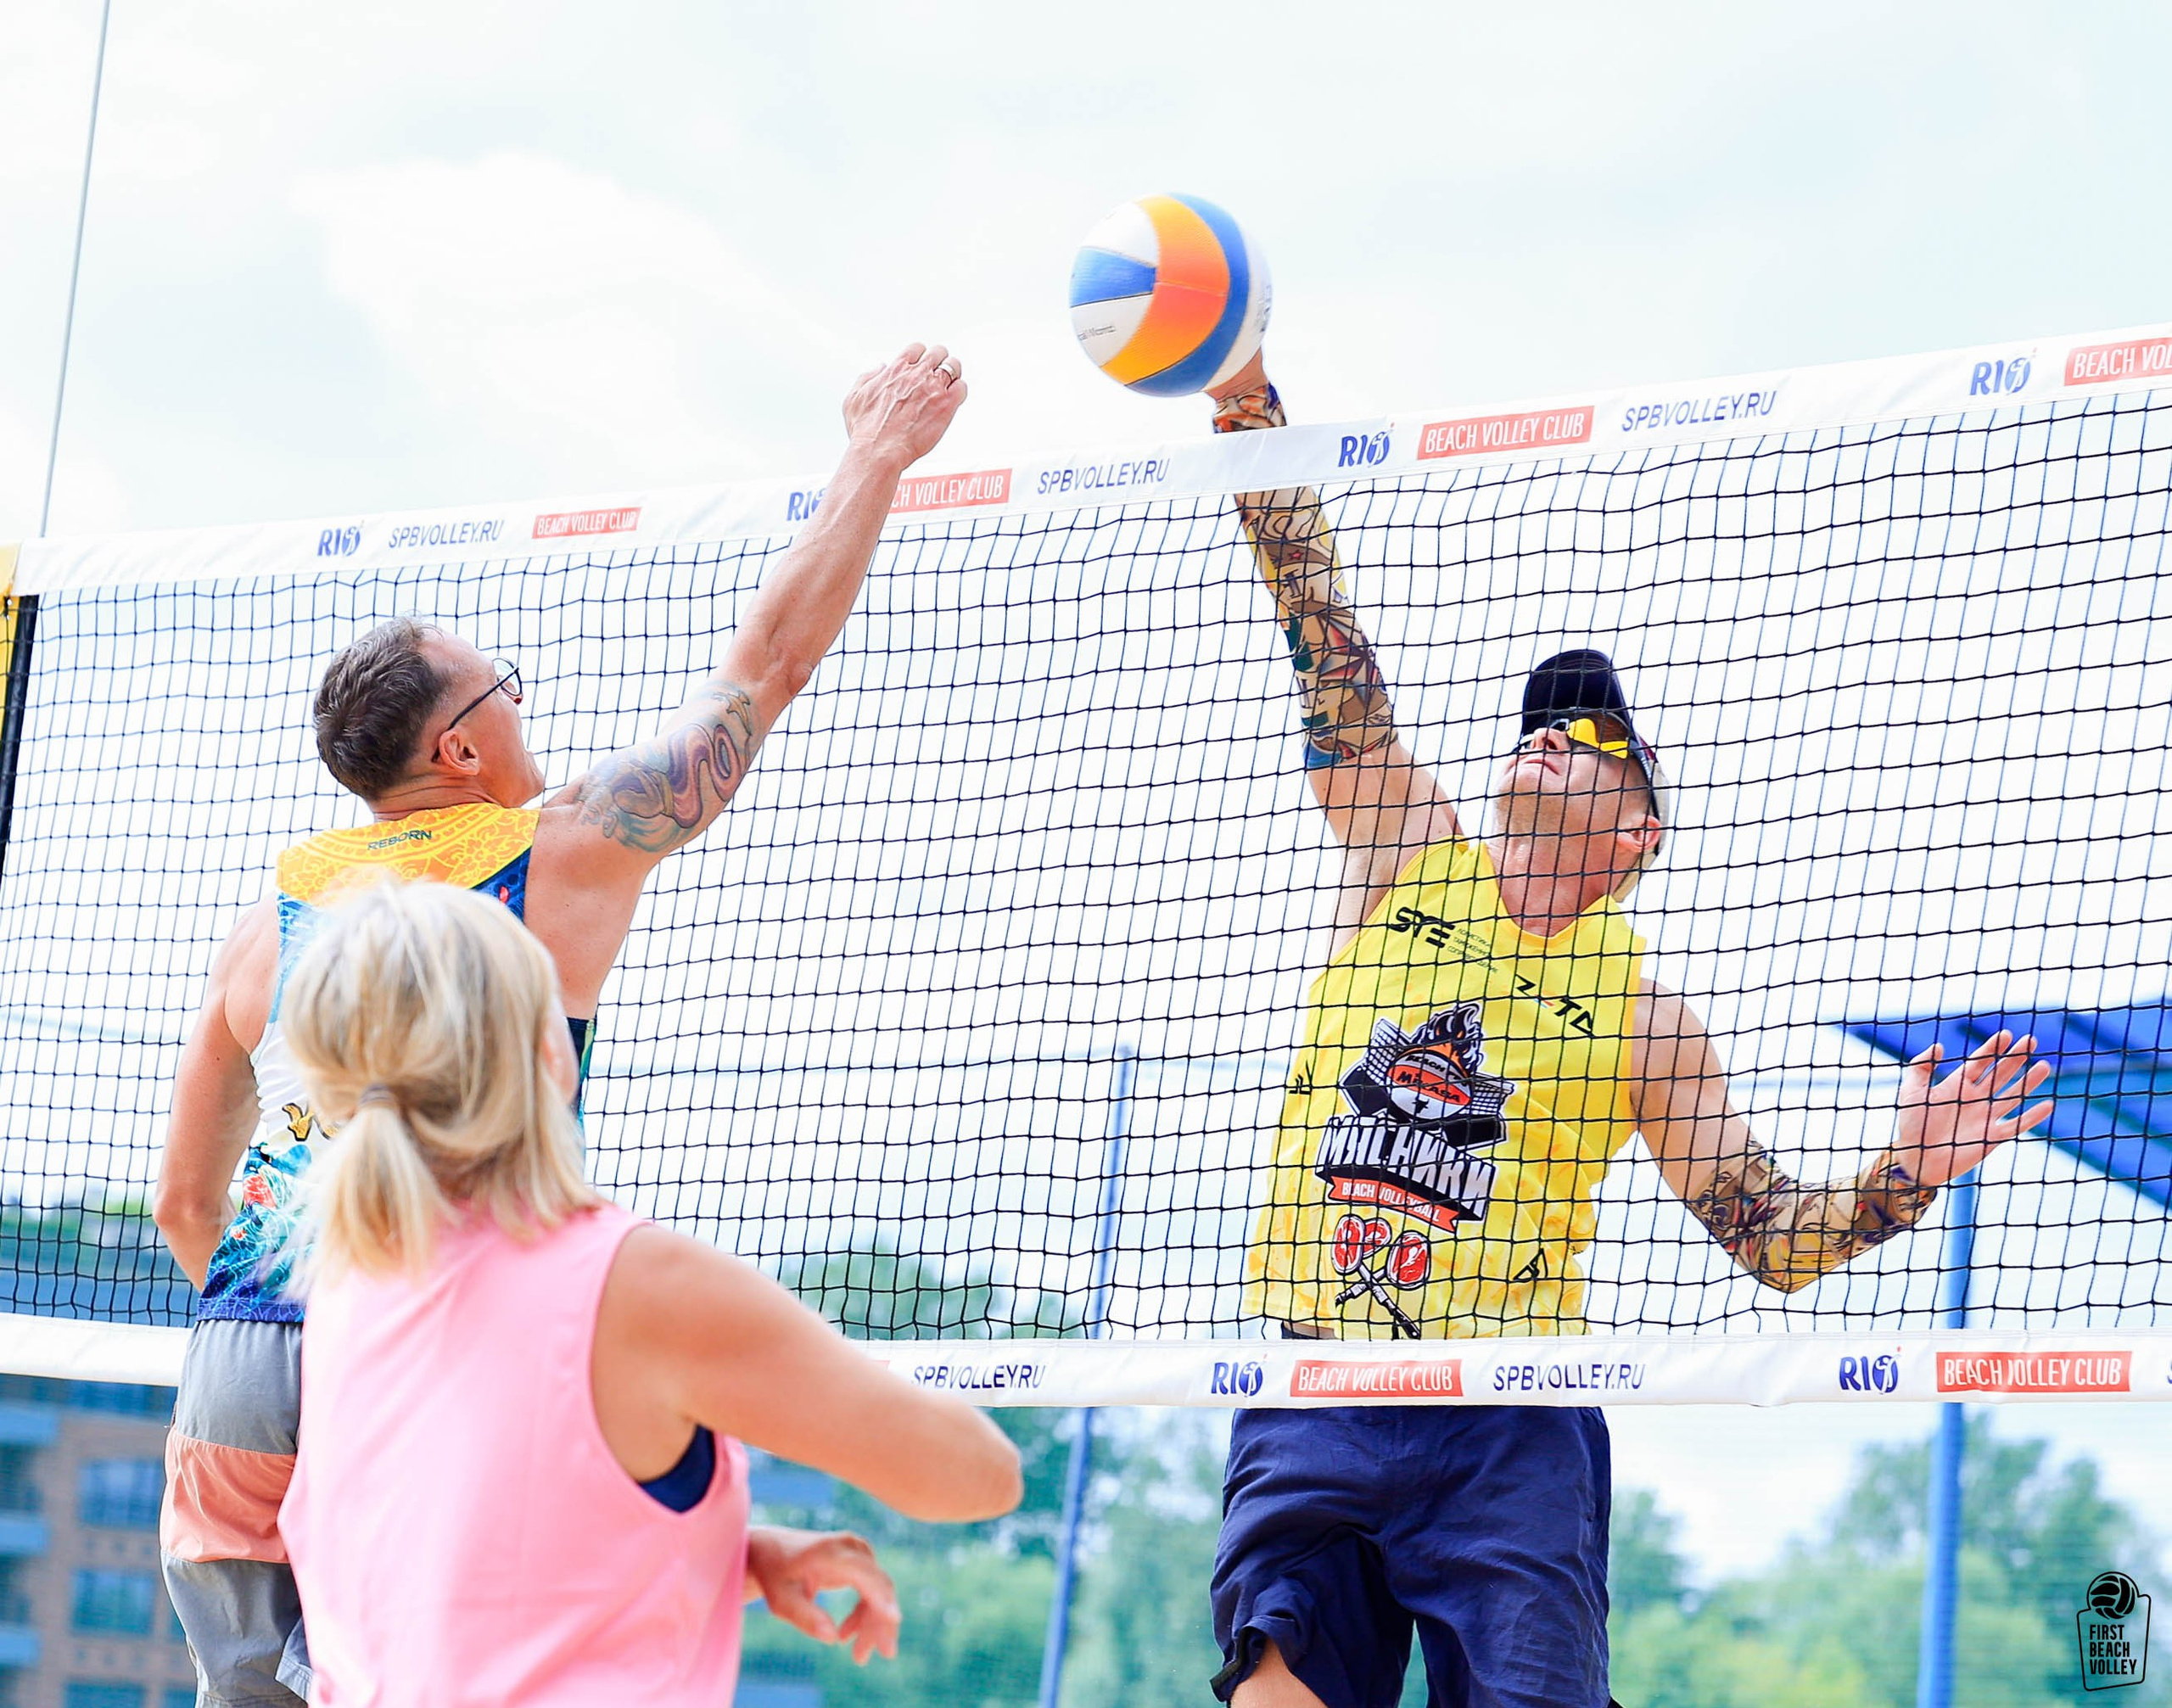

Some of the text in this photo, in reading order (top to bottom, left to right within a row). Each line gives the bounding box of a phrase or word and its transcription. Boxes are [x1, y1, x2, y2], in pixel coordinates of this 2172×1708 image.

[2072, 347, 2136, 379] BEACH
[1621, 390, 1777, 433] SPBVOLLEY.RU
[1425, 412, 1585, 454] BEACH VOLLEY CLUB
[915, 479, 967, 506] VOLLEY
[967, 474, 1005, 501] CLUB
[1037, 459, 1171, 495] SPBVOLLEY.RU
[389, 519, 506, 549] SPBVOLLEY.RU
[537, 511, 637, 536] BEACH VOLLEY CLUB
[367, 830, 432, 850] REBORN
[911, 1364, 1047, 1390] SPBVOLLEY.RU
[1298, 1364, 1453, 1392] BEACH VOLLEY CLUB
[1493, 1363, 1645, 1392] SPBVOLLEY.RU
[1944, 1358, 2003, 1386] BEACH
[2074, 1358, 2123, 1386] CLUB
